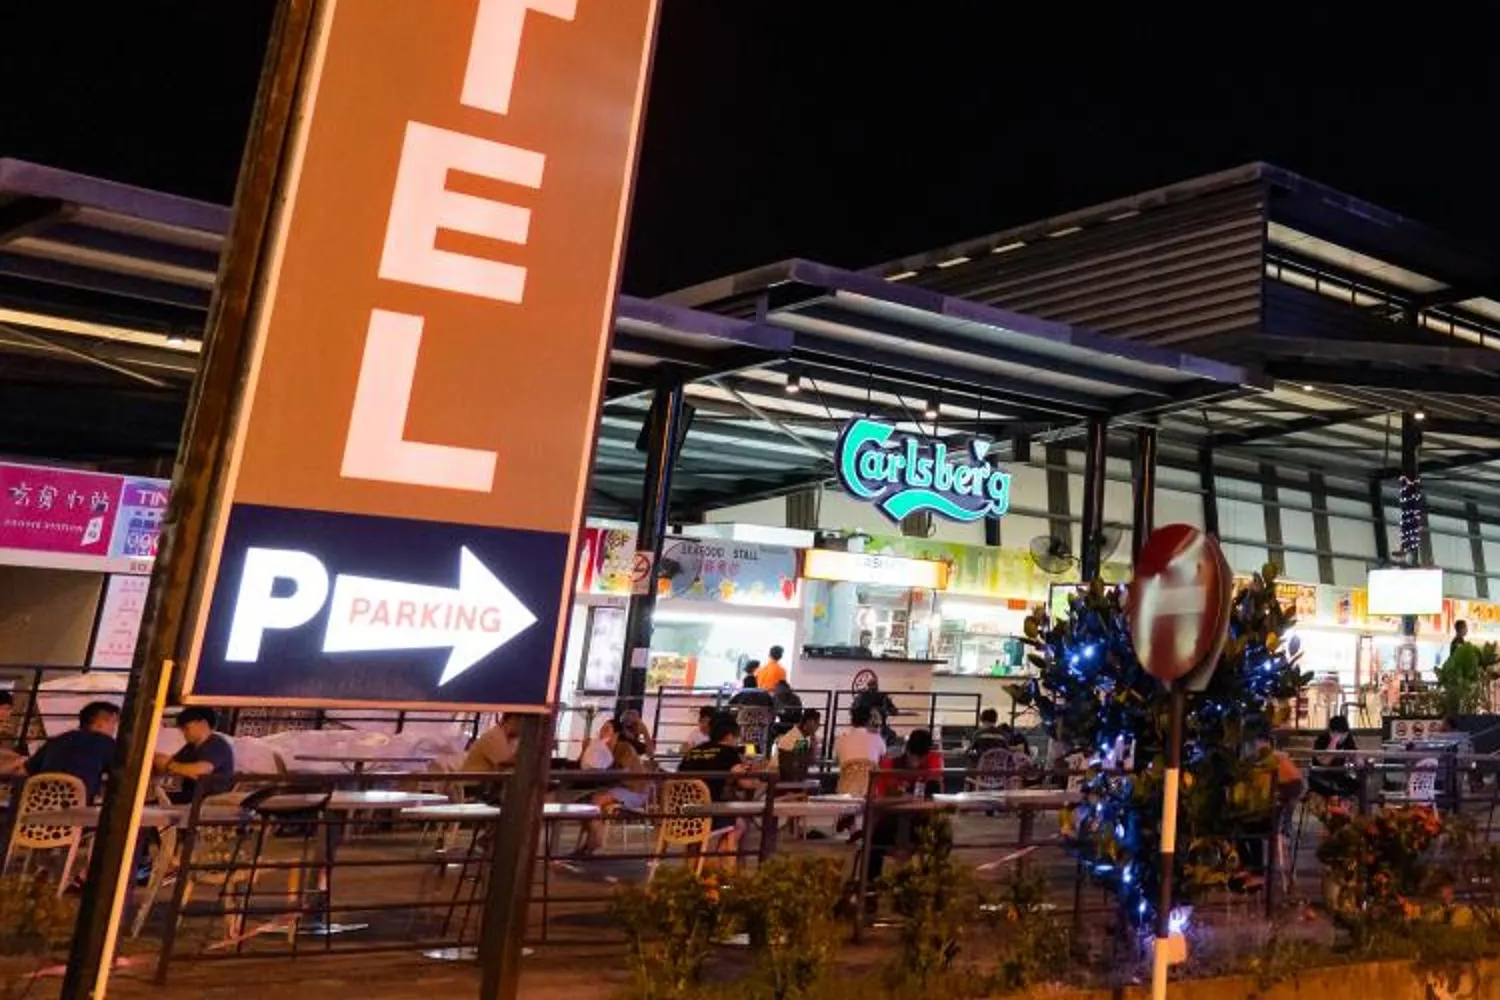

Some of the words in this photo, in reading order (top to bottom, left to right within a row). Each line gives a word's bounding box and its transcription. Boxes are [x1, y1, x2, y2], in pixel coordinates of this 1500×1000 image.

[841, 419, 1012, 518] Carlsberg
[224, 546, 329, 663] P
[349, 597, 501, 634] PARKING
